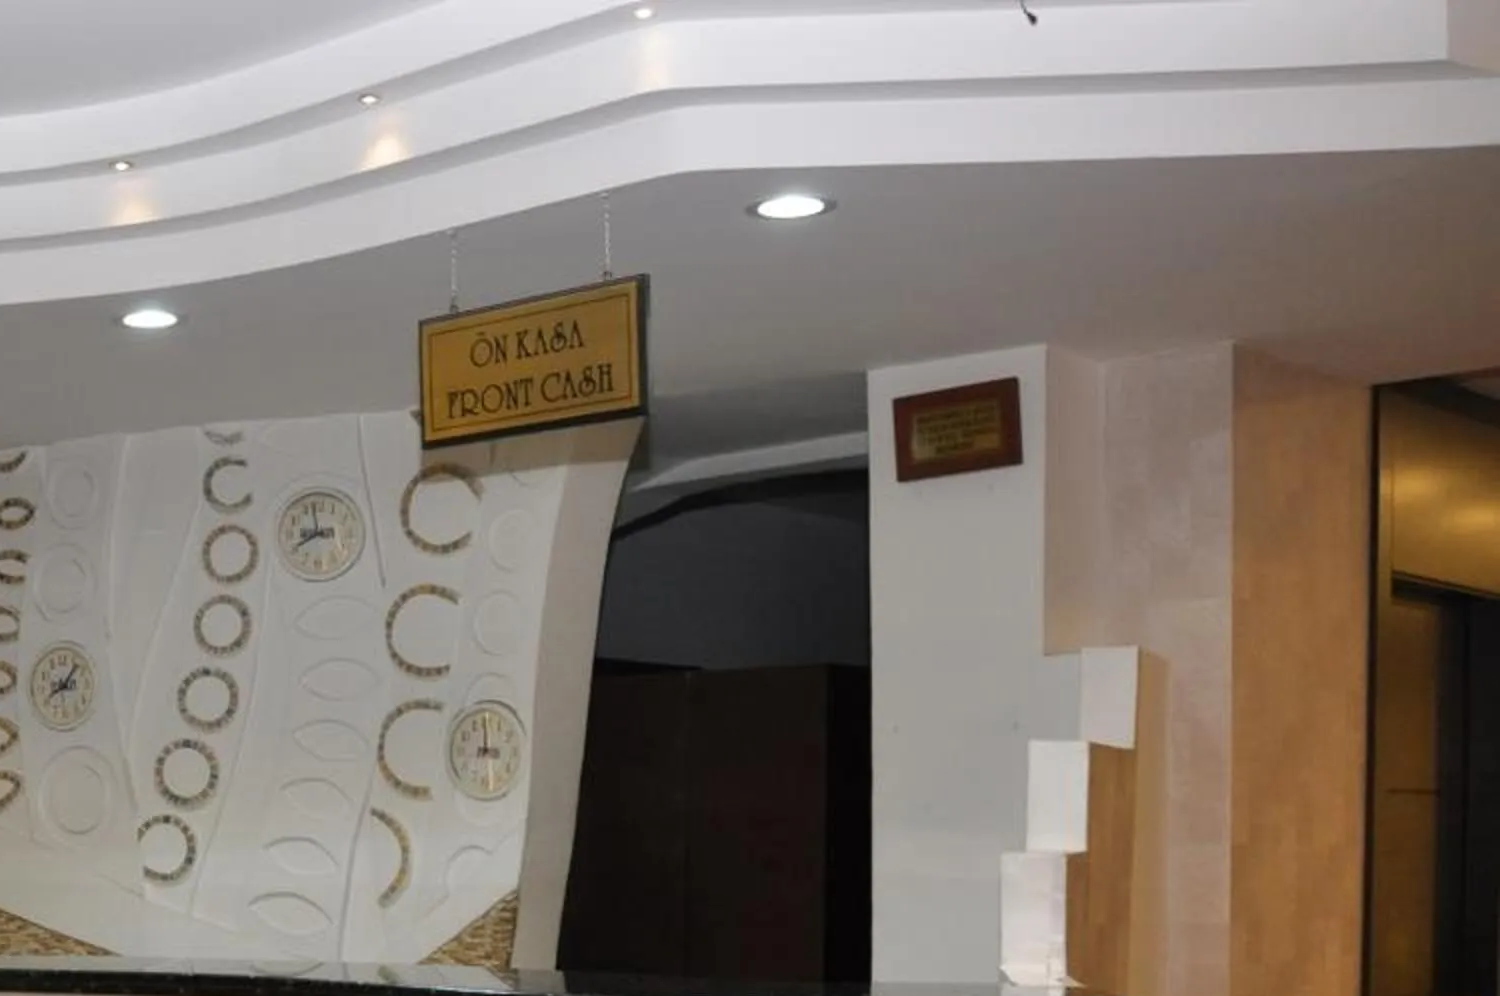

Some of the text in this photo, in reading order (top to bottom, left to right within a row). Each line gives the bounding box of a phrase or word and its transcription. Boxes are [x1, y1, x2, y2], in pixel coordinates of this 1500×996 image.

[469, 319, 585, 367] ÖN KASA
[446, 363, 614, 419] FRONT CASH
